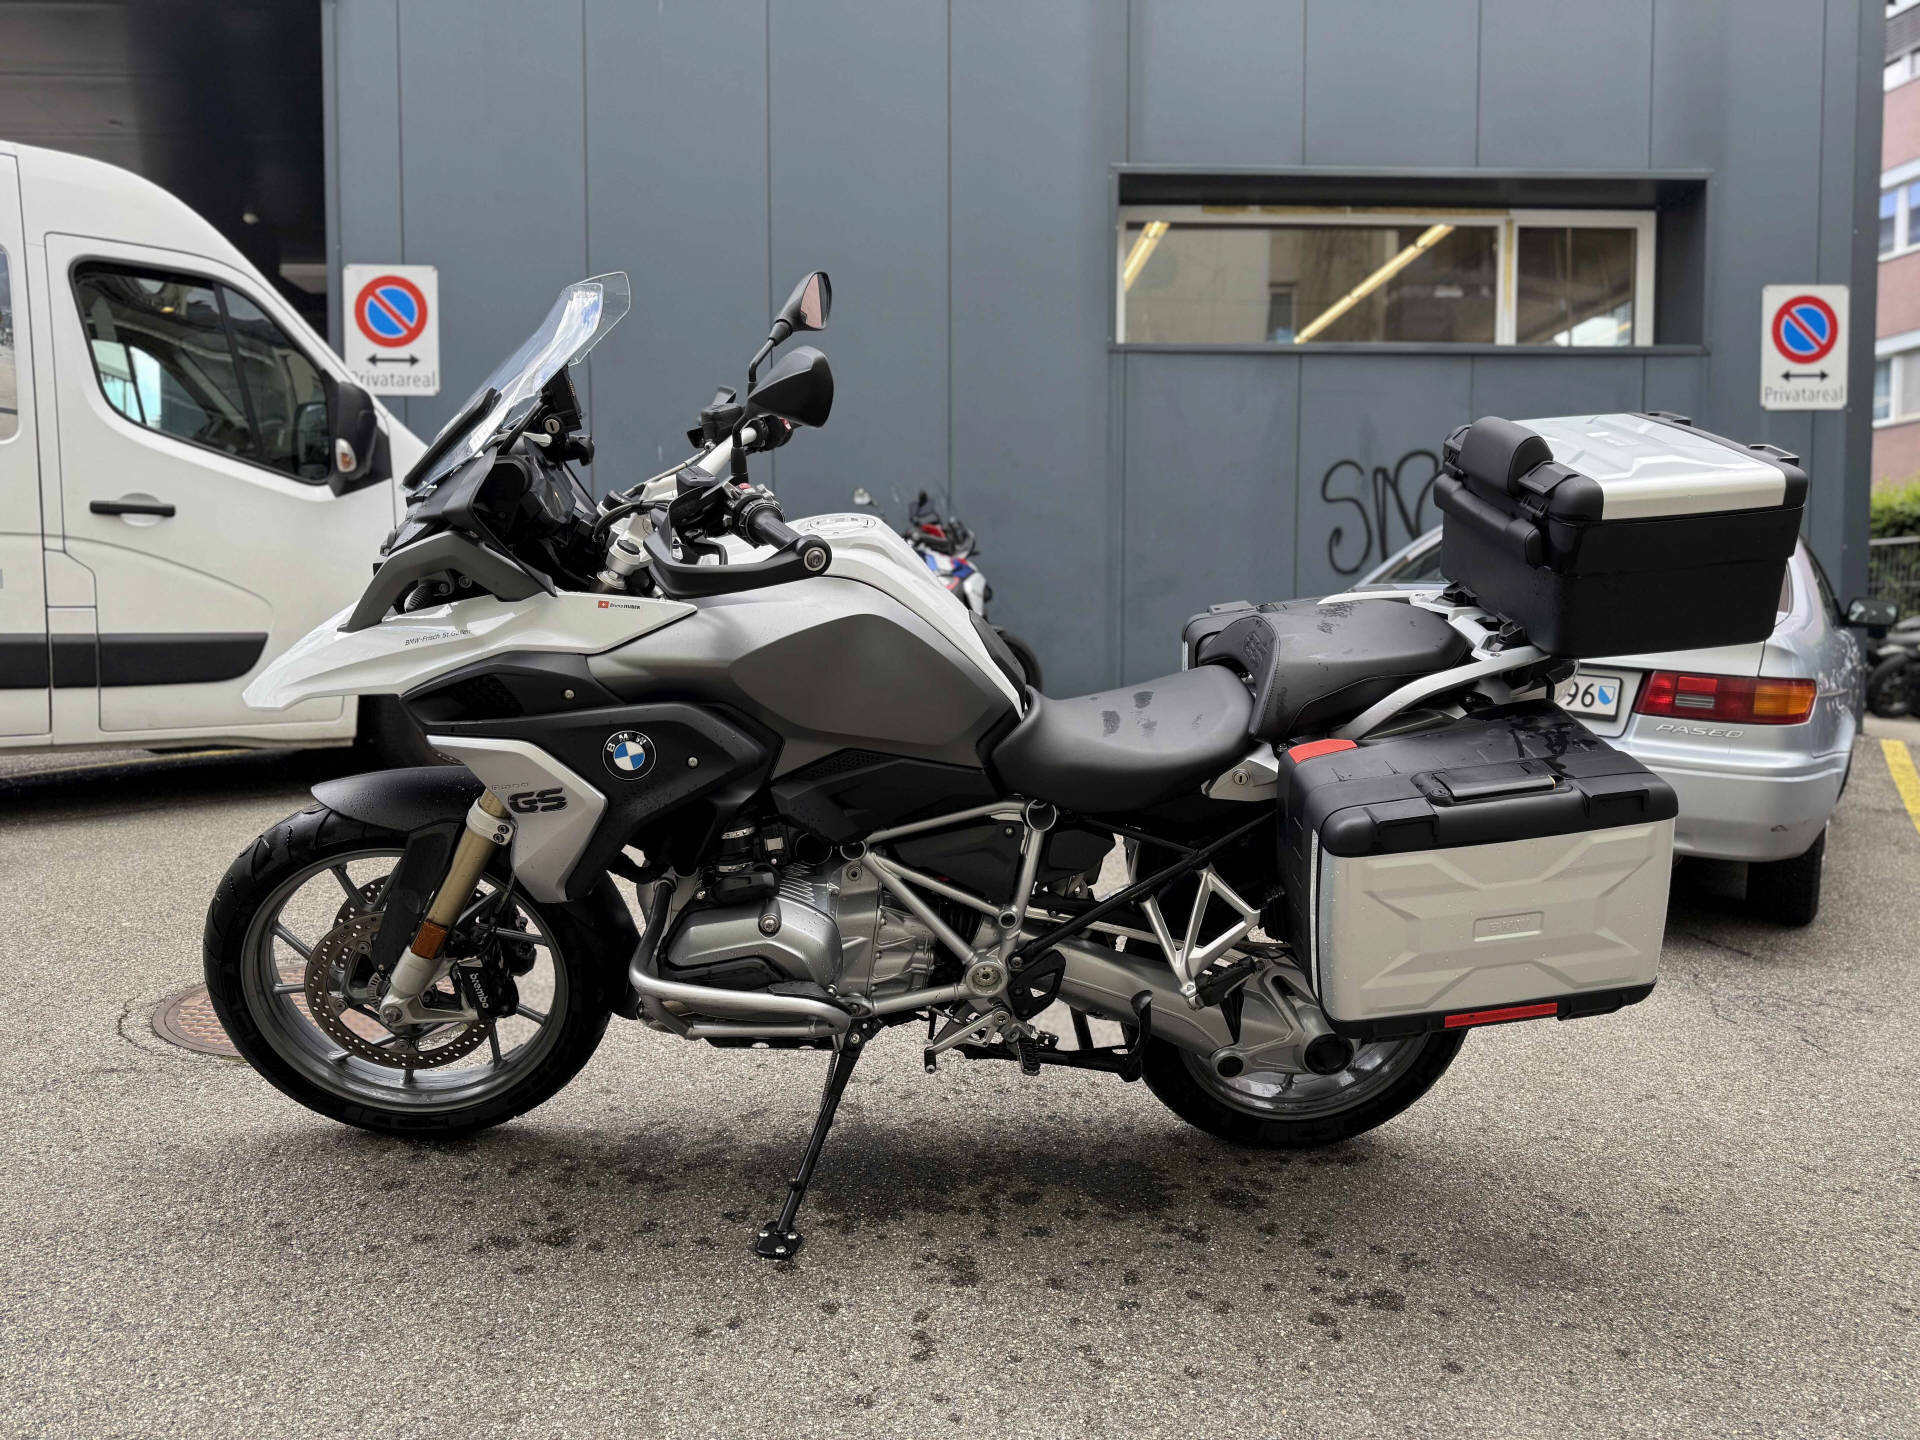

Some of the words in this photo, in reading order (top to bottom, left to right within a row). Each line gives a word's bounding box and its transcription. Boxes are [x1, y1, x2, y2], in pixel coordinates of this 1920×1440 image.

[1764, 385, 1843, 402] Privatareal
[1655, 723, 1745, 739] PASEO
[606, 732, 647, 752] BMW
[508, 787, 568, 813] GS
[469, 972, 489, 1009] brembo
